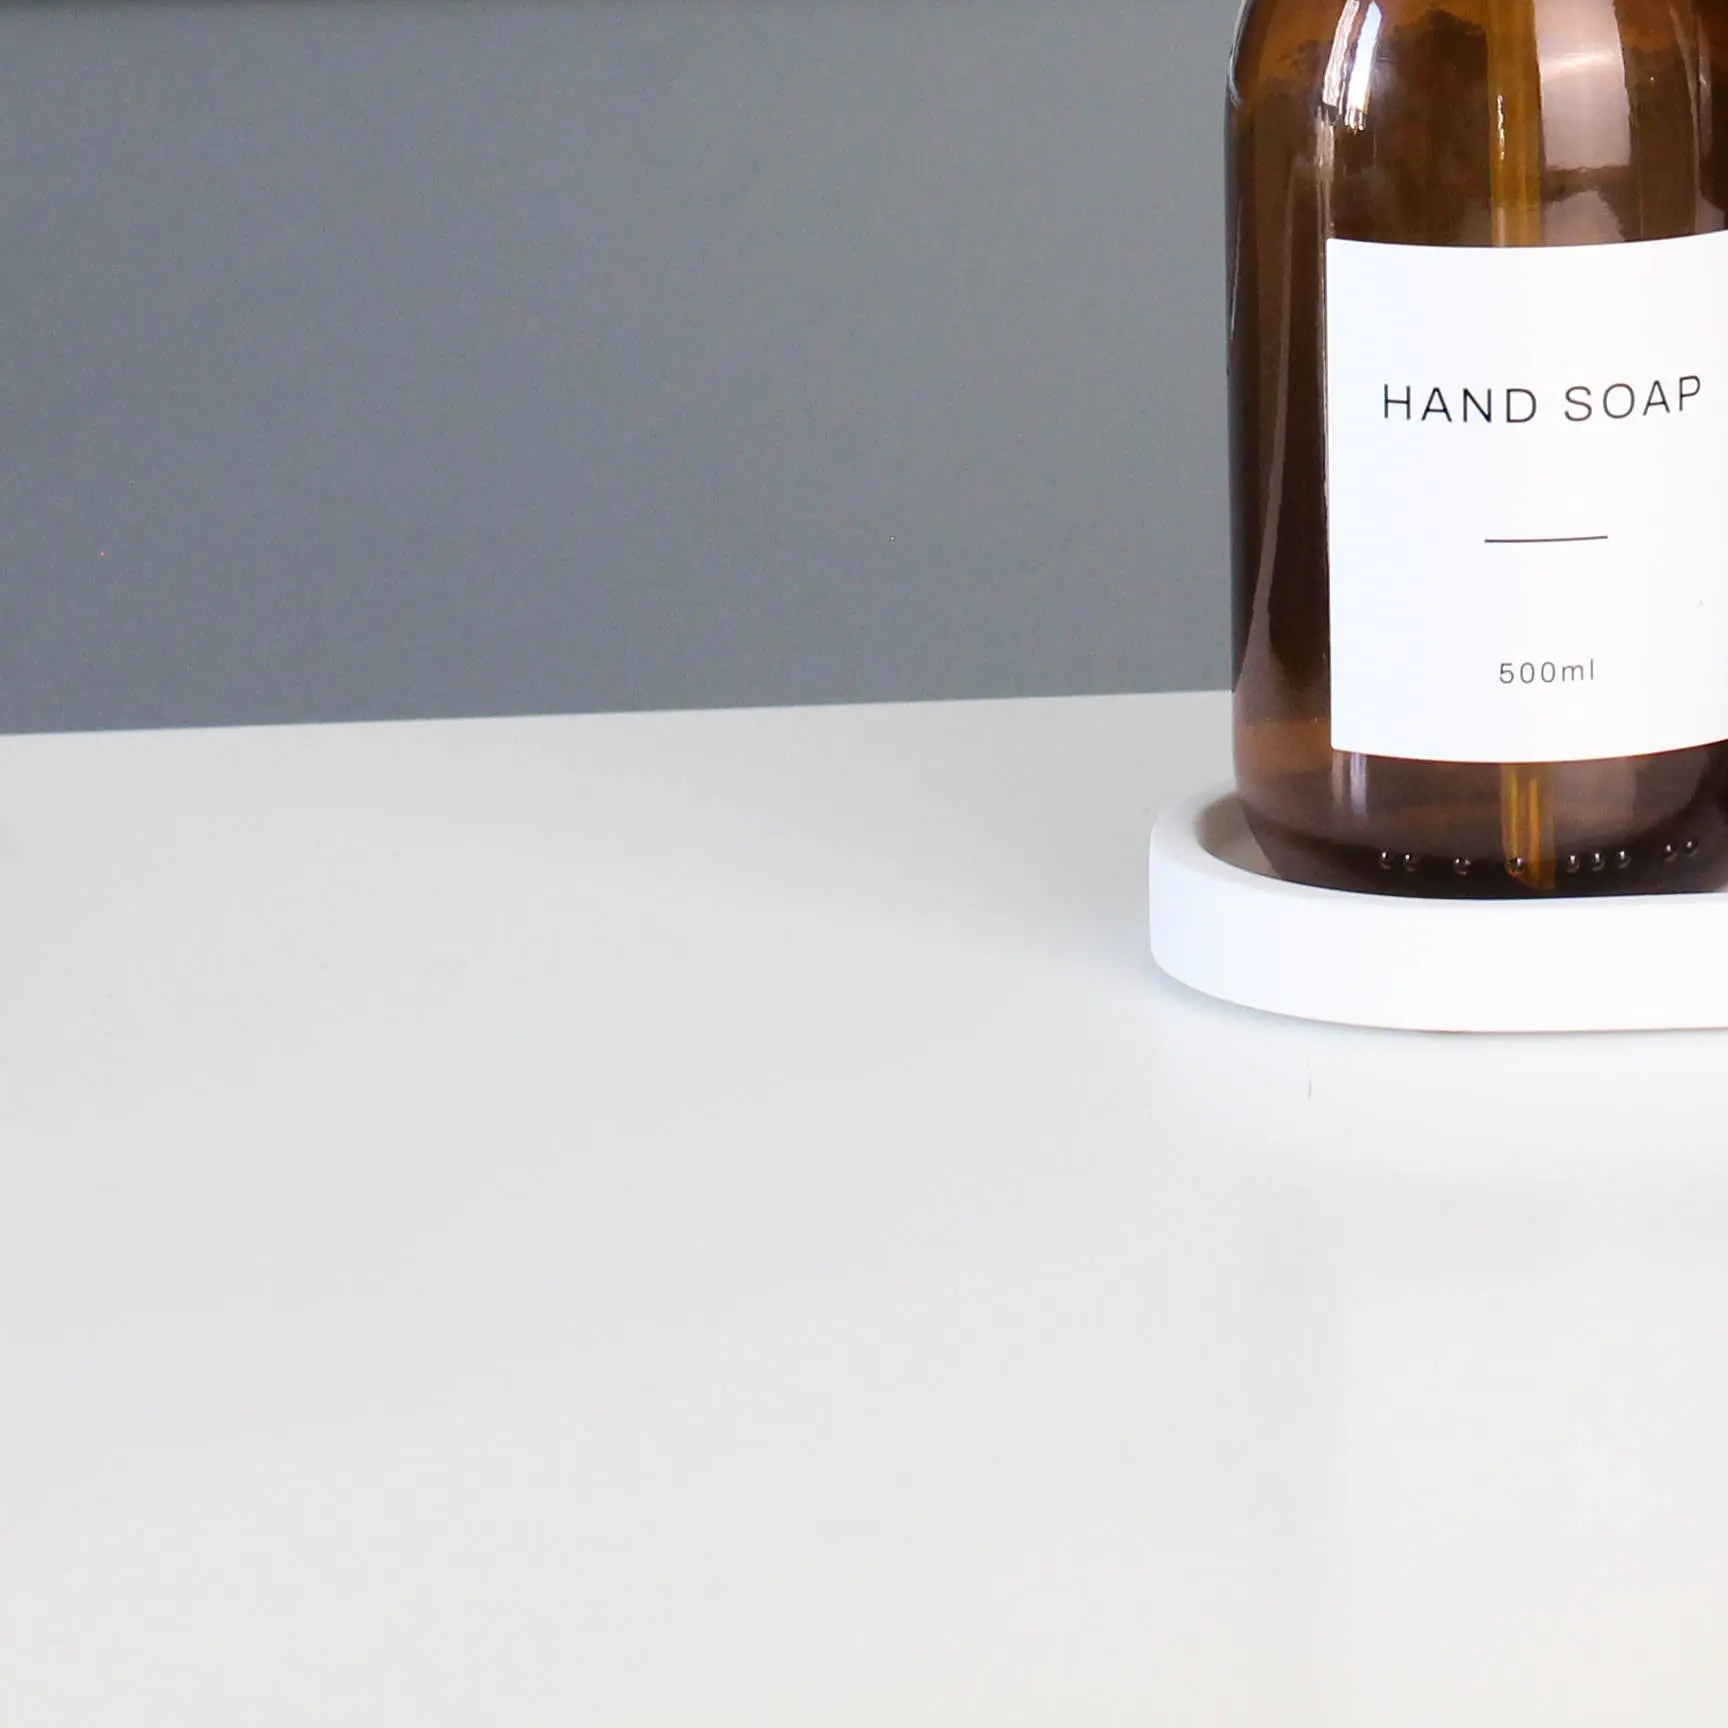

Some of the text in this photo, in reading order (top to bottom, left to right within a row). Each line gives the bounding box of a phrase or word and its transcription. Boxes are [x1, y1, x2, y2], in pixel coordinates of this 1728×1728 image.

[1382, 375, 1702, 424] HAND SOAP
[1498, 659, 1595, 685] 500ml
